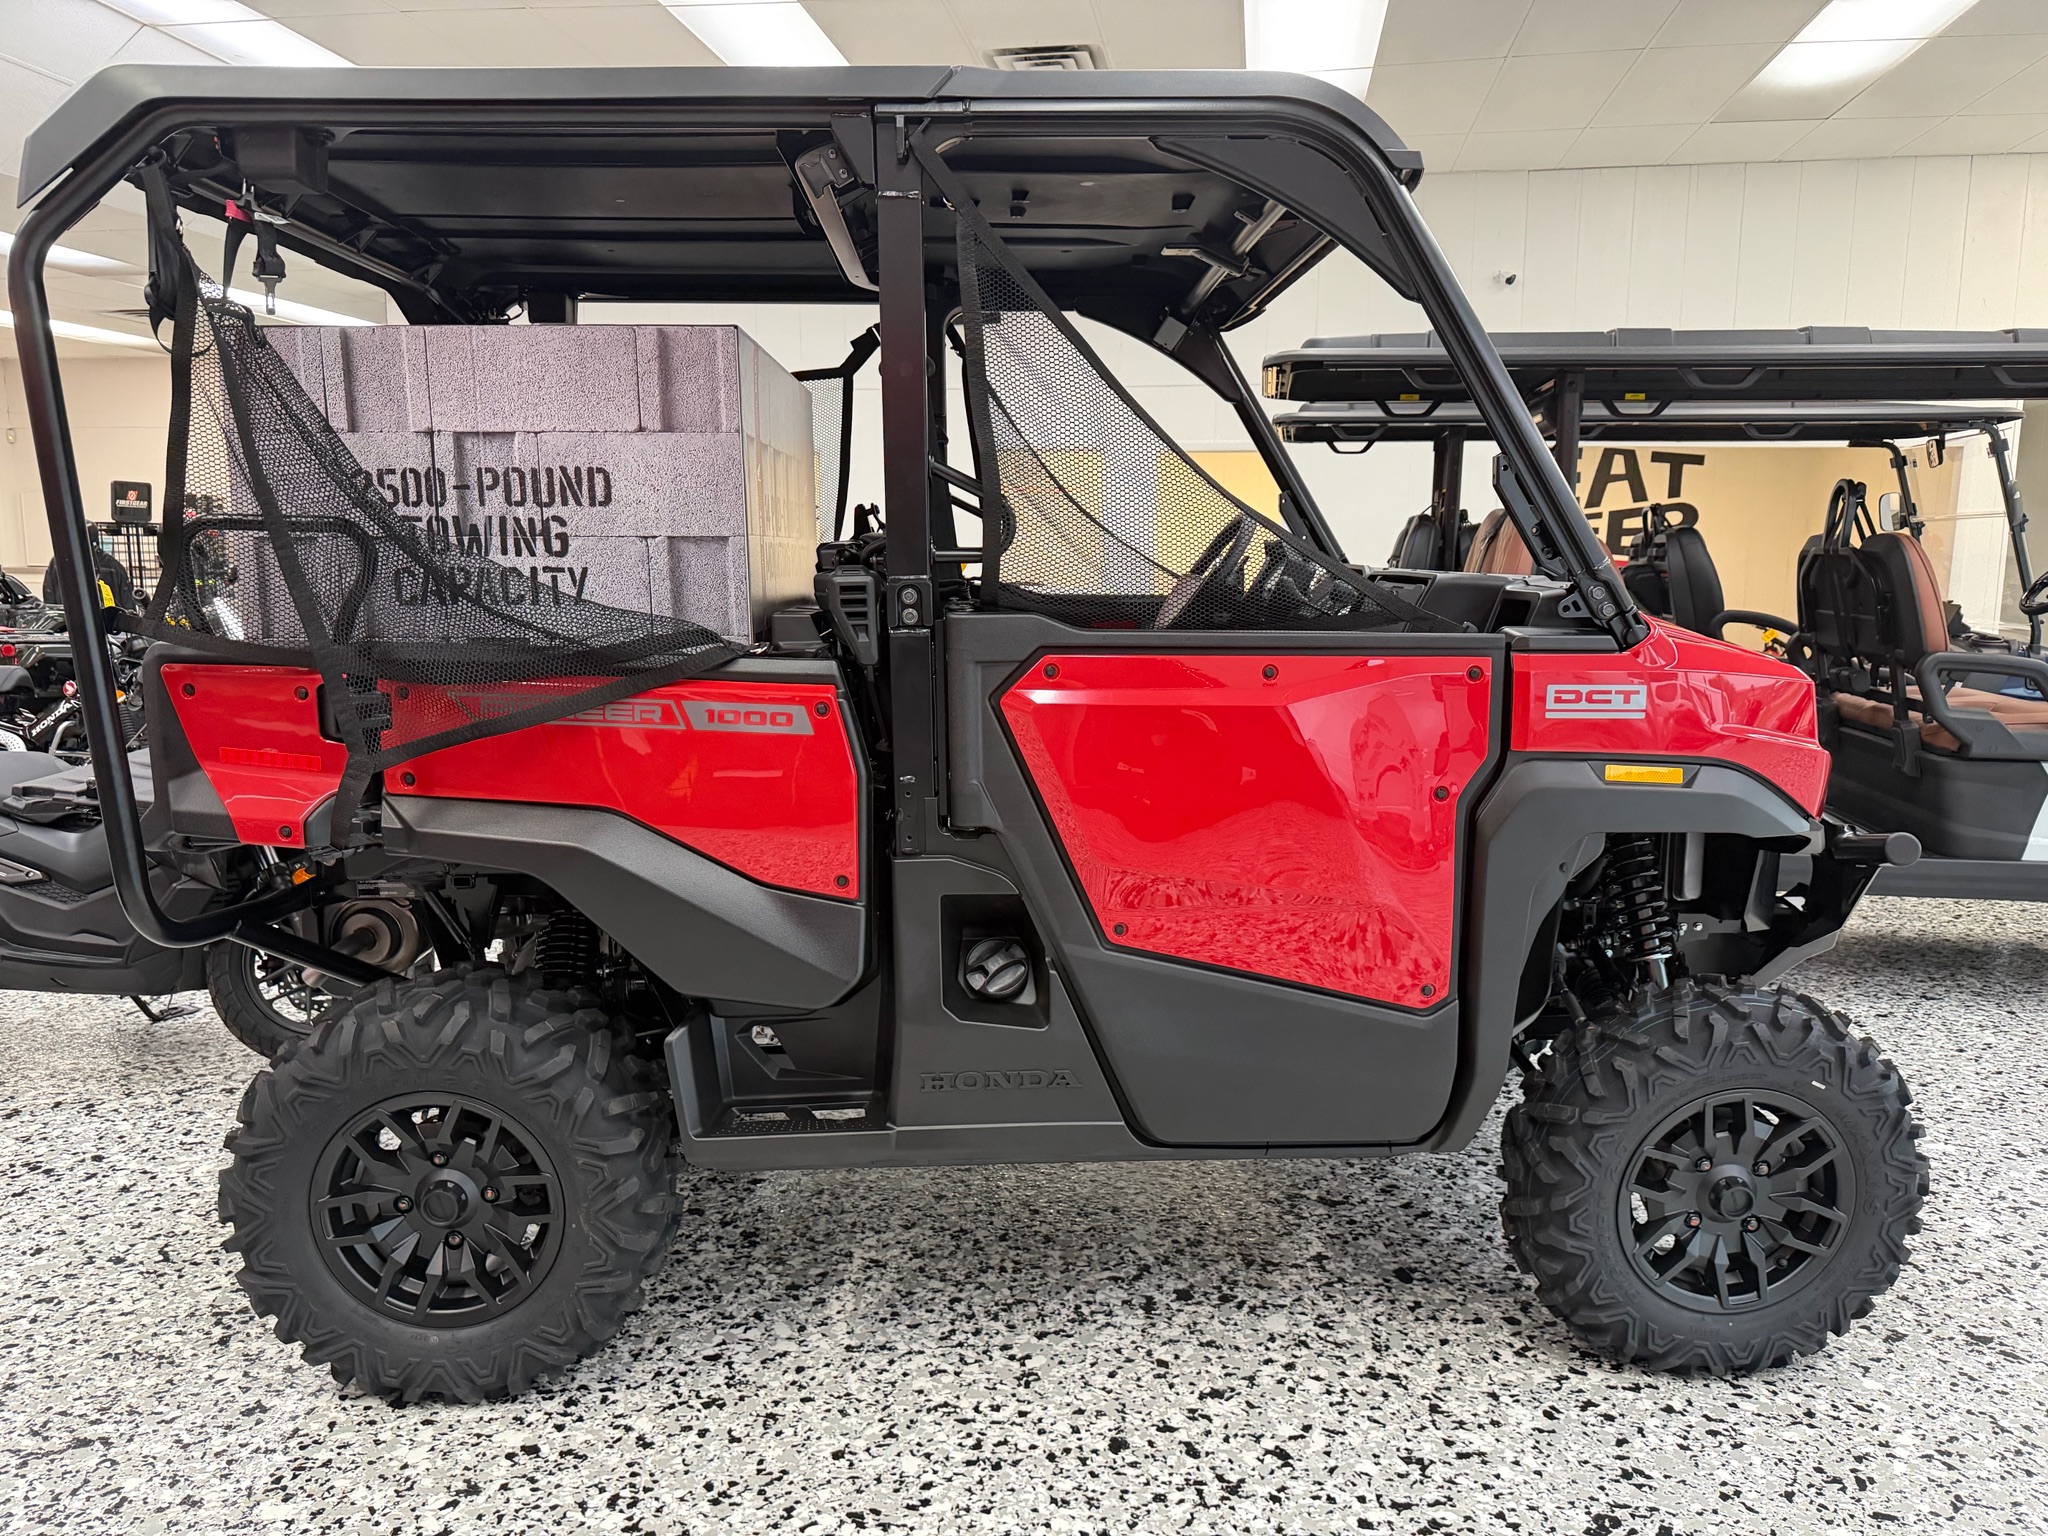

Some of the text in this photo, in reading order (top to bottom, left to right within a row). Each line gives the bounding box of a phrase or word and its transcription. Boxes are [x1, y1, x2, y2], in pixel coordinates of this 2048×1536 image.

[1576, 447, 1706, 509] AT
[1553, 689, 1641, 705] DCT
[31, 700, 73, 737] HONDA
[704, 708, 794, 727] 1000
[919, 1069, 1084, 1093] HONDA
